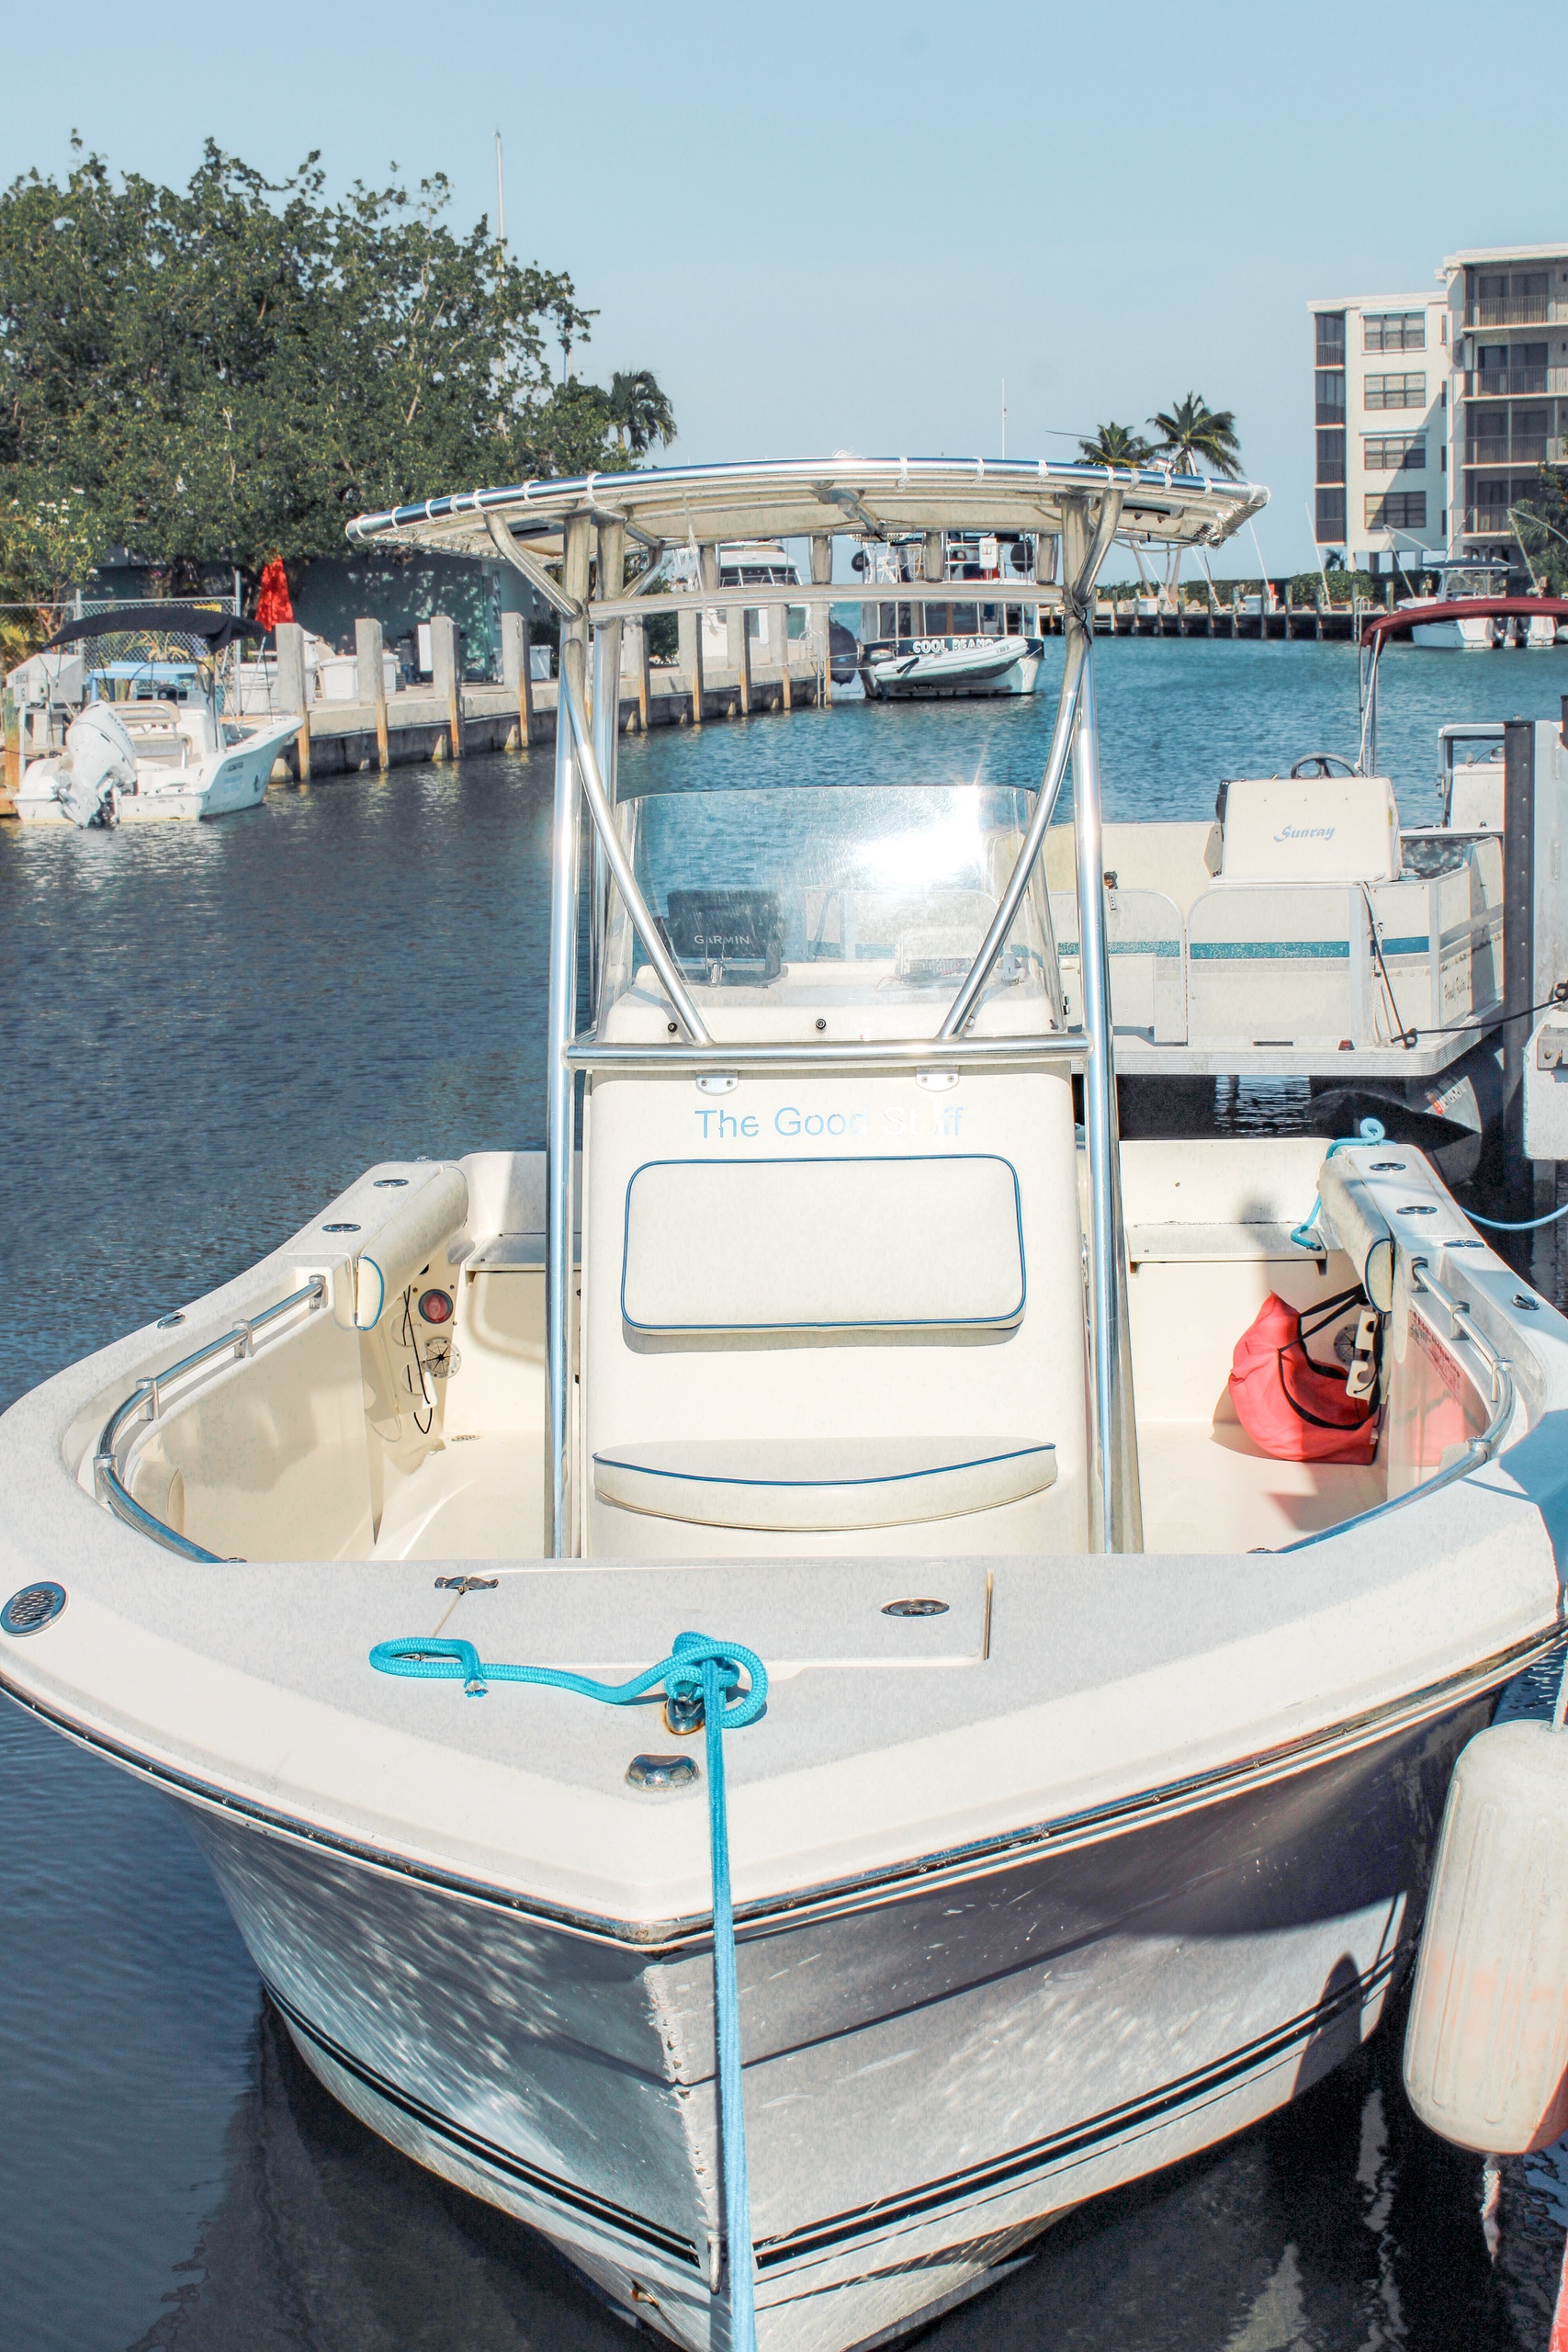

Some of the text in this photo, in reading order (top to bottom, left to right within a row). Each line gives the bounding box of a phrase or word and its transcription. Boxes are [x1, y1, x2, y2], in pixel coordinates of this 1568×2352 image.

[912, 639, 948, 654] COOL
[1273, 824, 1337, 843] Sunray
[694, 934, 750, 944] GARMIN
[694, 1109, 761, 1139] The
[774, 1106, 868, 1137] Good
